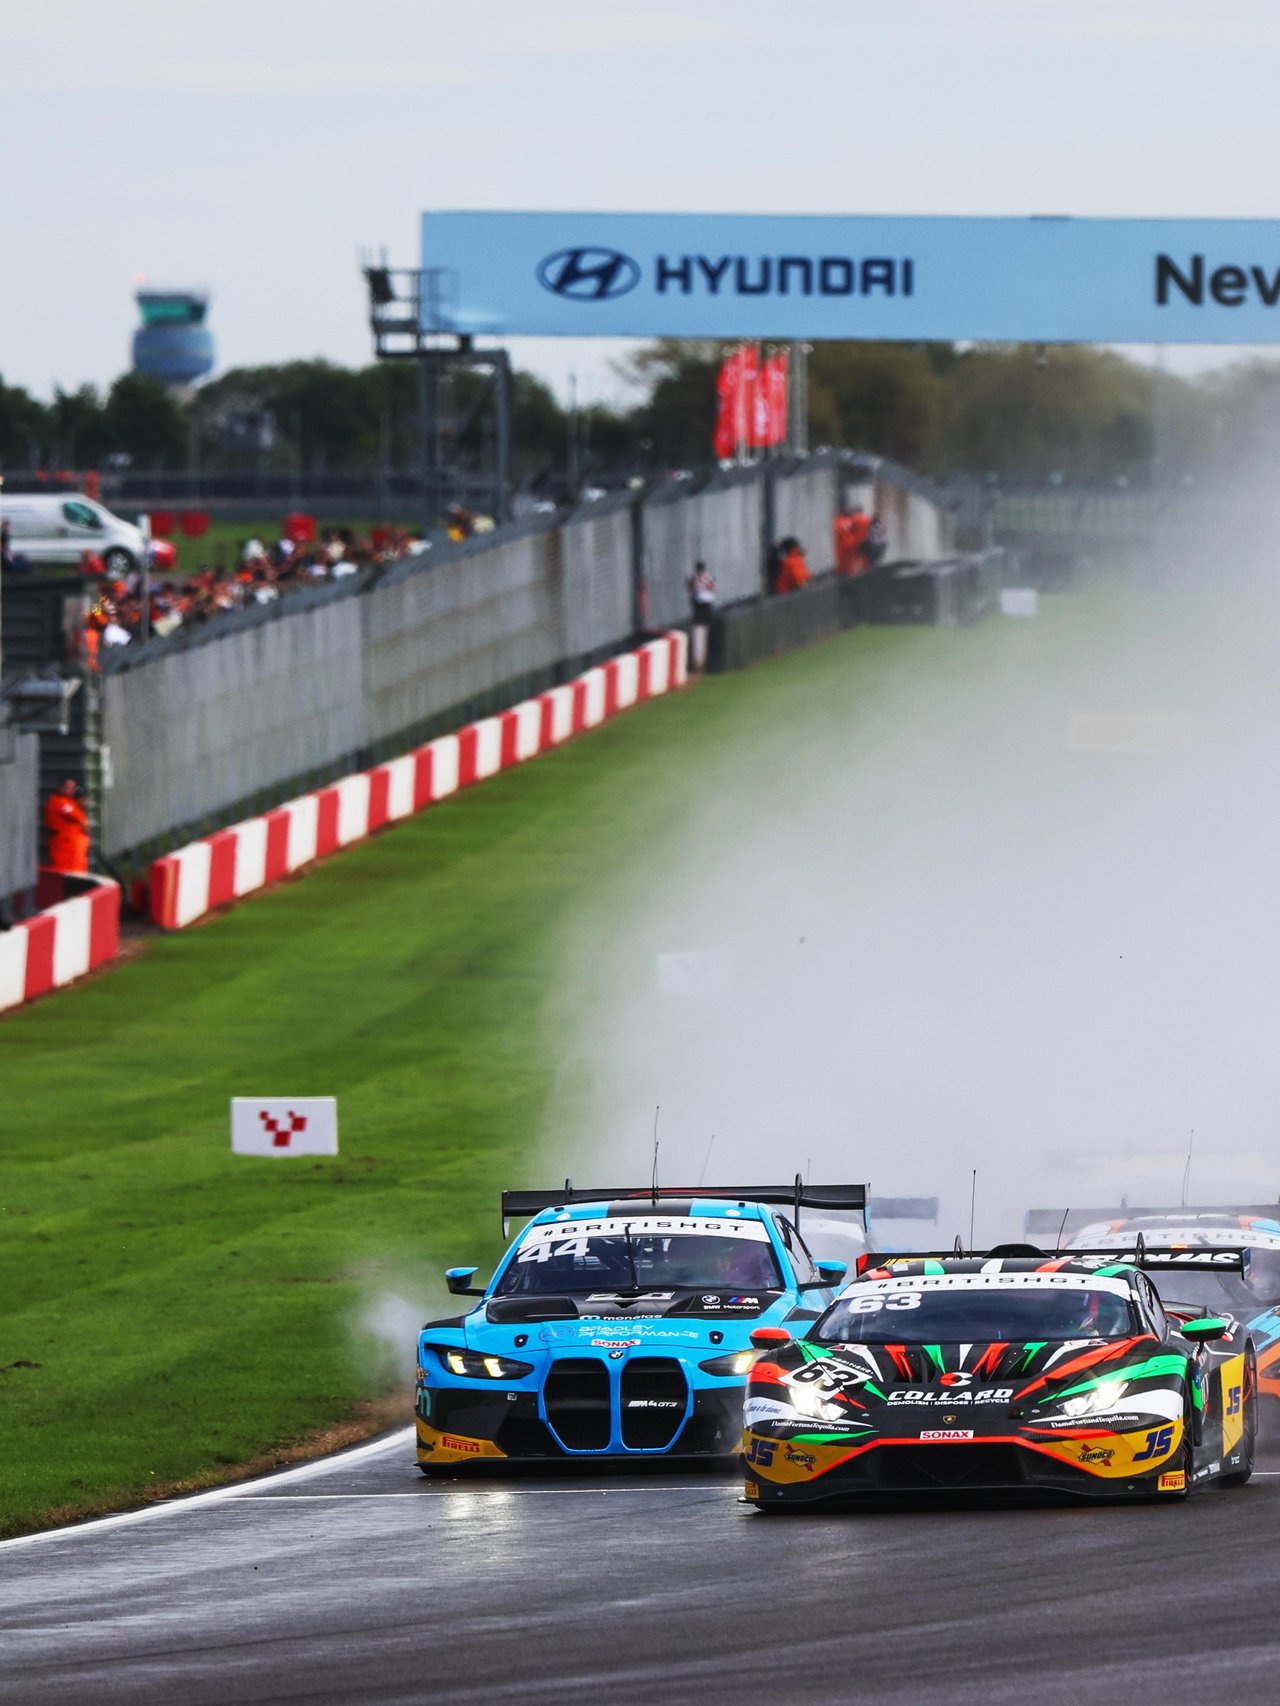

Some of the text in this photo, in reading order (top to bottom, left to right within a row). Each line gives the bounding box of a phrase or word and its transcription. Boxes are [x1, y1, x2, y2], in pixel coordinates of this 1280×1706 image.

[656, 255, 913, 297] HYUNDAI
[543, 1221, 744, 1237] #BRITISHGT
[517, 1238, 591, 1264] 44
[877, 1278, 1093, 1289] #BRITISHGT
[848, 1292, 922, 1314] 63
[578, 1324, 654, 1333] BRADLEY
[593, 1339, 637, 1347] SONAX
[791, 1362, 859, 1392] 63
[888, 1388, 1014, 1401] COLLARD
[1226, 1385, 1241, 1416] JS
[921, 1431, 969, 1439] SONAX
[442, 1436, 480, 1453] PIRELLI
[1131, 1425, 1176, 1462] JS
[746, 1438, 779, 1468] JS
[786, 1453, 815, 1463] SUNOCO
[1080, 1450, 1114, 1462] SUNOCO
